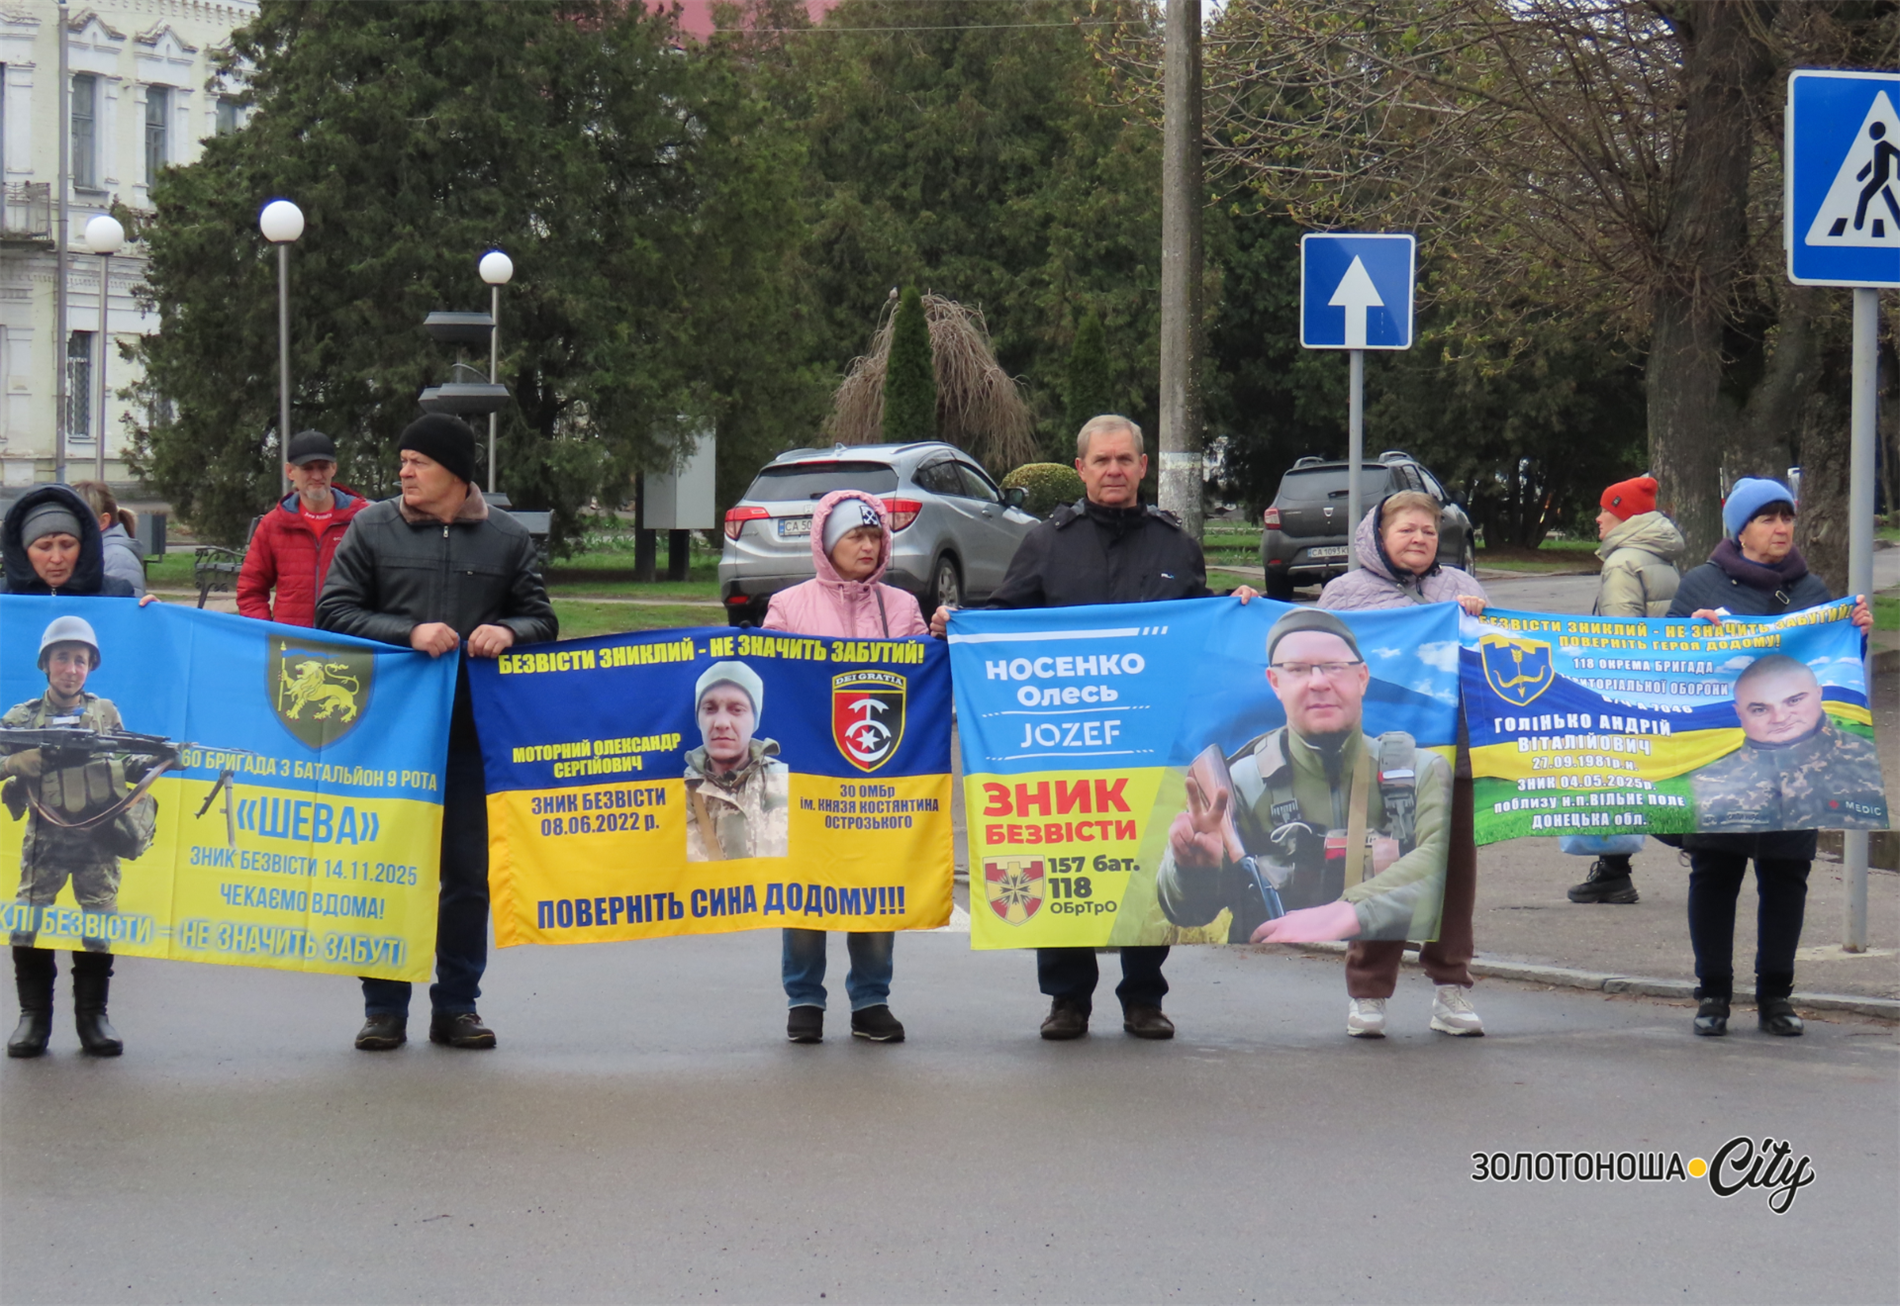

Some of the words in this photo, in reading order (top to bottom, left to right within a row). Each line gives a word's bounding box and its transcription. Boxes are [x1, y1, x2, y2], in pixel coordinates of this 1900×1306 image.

[785, 521, 799, 531] CA
[1567, 622, 1648, 637] ЗНИКЛИЙ
[1665, 625, 1685, 638] НЕ
[1691, 622, 1769, 638] ЗНАЧИТЬ
[1776, 604, 1854, 630] ЗАБУТИЙ!
[499, 650, 595, 674] БЕЗВІСТИ
[599, 637, 695, 668] ЗНИКЛИЙ
[709, 636, 735, 657] НЕ
[737, 634, 827, 661] ЗНАЧИТЬ
[831, 640, 925, 664] ЗАБУТИЙ!
[1558, 635, 1648, 650] ПОВЕРНІТЬ
[1652, 639, 1700, 651] ГЕРОЯ
[1706, 634, 1782, 652] ДОДОМУ!
[985, 653, 1145, 681] НОСЕНКО
[1573, 658, 1594, 669] 118
[1599, 659, 1651, 671] ОКРЕМА
[1654, 660, 1714, 675] БРИГАДА
[835, 674, 857, 685] DEI
[858, 672, 903, 686] GRATIA
[1560, 673, 1667, 694] ИТОРІАЛЬНОЇ
[1670, 681, 1729, 696] ОБОРОНИ
[1017, 685, 1118, 706] Олесь
[1020, 719, 1121, 748] JOZEF
[1494, 713, 1592, 733] ГОЛІНЬКО
[1599, 714, 1671, 736] АНДРІЙ
[512, 739, 591, 763] МОТОРНИЙ
[593, 732, 682, 757] ОЛЕКСАНДР
[1517, 732, 1652, 756] ВІТАЛІЙОВИЧ
[181, 748, 200, 768] 60
[205, 751, 277, 776] БРИГАДА
[294, 760, 384, 787] БАТАЛЬЙОН
[386, 770, 397, 788] 9
[401, 770, 438, 792] РОТА
[553, 755, 643, 778] СЕРГІЙОВИЧ
[839, 784, 856, 798] 30
[859, 784, 895, 799] ОМБр
[1517, 776, 1556, 791] ЗНИК
[1560, 775, 1658, 791] 04.05.2025р.
[531, 793, 579, 815] ЗНИК
[582, 787, 667, 811] БЕЗВІСТИ
[818, 798, 856, 813] КНЯЗЯ
[859, 798, 939, 814] КОСТЯНТИНА
[982, 778, 1131, 817] ЗНИК
[1493, 796, 1557, 815] поблизу
[1648, 793, 1685, 807] ПОЛЕ
[1845, 801, 1882, 816] MEDIC
[236, 796, 380, 845] «ШЕВА»
[541, 812, 640, 837] 08.06.2022
[644, 813, 660, 832] р.
[825, 815, 913, 830] ОСТРОЗЬКОГО
[1531, 812, 1610, 830] ДОНЕЦЬКА
[1614, 811, 1648, 827] обл.
[985, 820, 1137, 845] БЕЗВІСТИ
[189, 846, 237, 868] ЗНИК
[240, 850, 318, 877] БЕЗВІСТИ
[324, 859, 418, 886] 14.11.2025
[1048, 856, 1086, 873] 157
[1092, 854, 1140, 873] бат.
[1048, 876, 1092, 899] 118
[220, 883, 308, 912] ЧЕКАЄМО
[311, 892, 385, 919] ВДОМА!
[537, 892, 684, 929] ПОВЕРНІТЬ
[691, 885, 758, 918] СИНА
[763, 882, 905, 918] ДОДОМУ!!!
[1050, 901, 1117, 916] ОБрТрО
[40, 907, 151, 943] БЕЗВІСТИ
[181, 920, 211, 949] НЕ
[216, 923, 317, 958] ЗНАЧИТЬ
[323, 933, 406, 966] ЗАБУТІ
